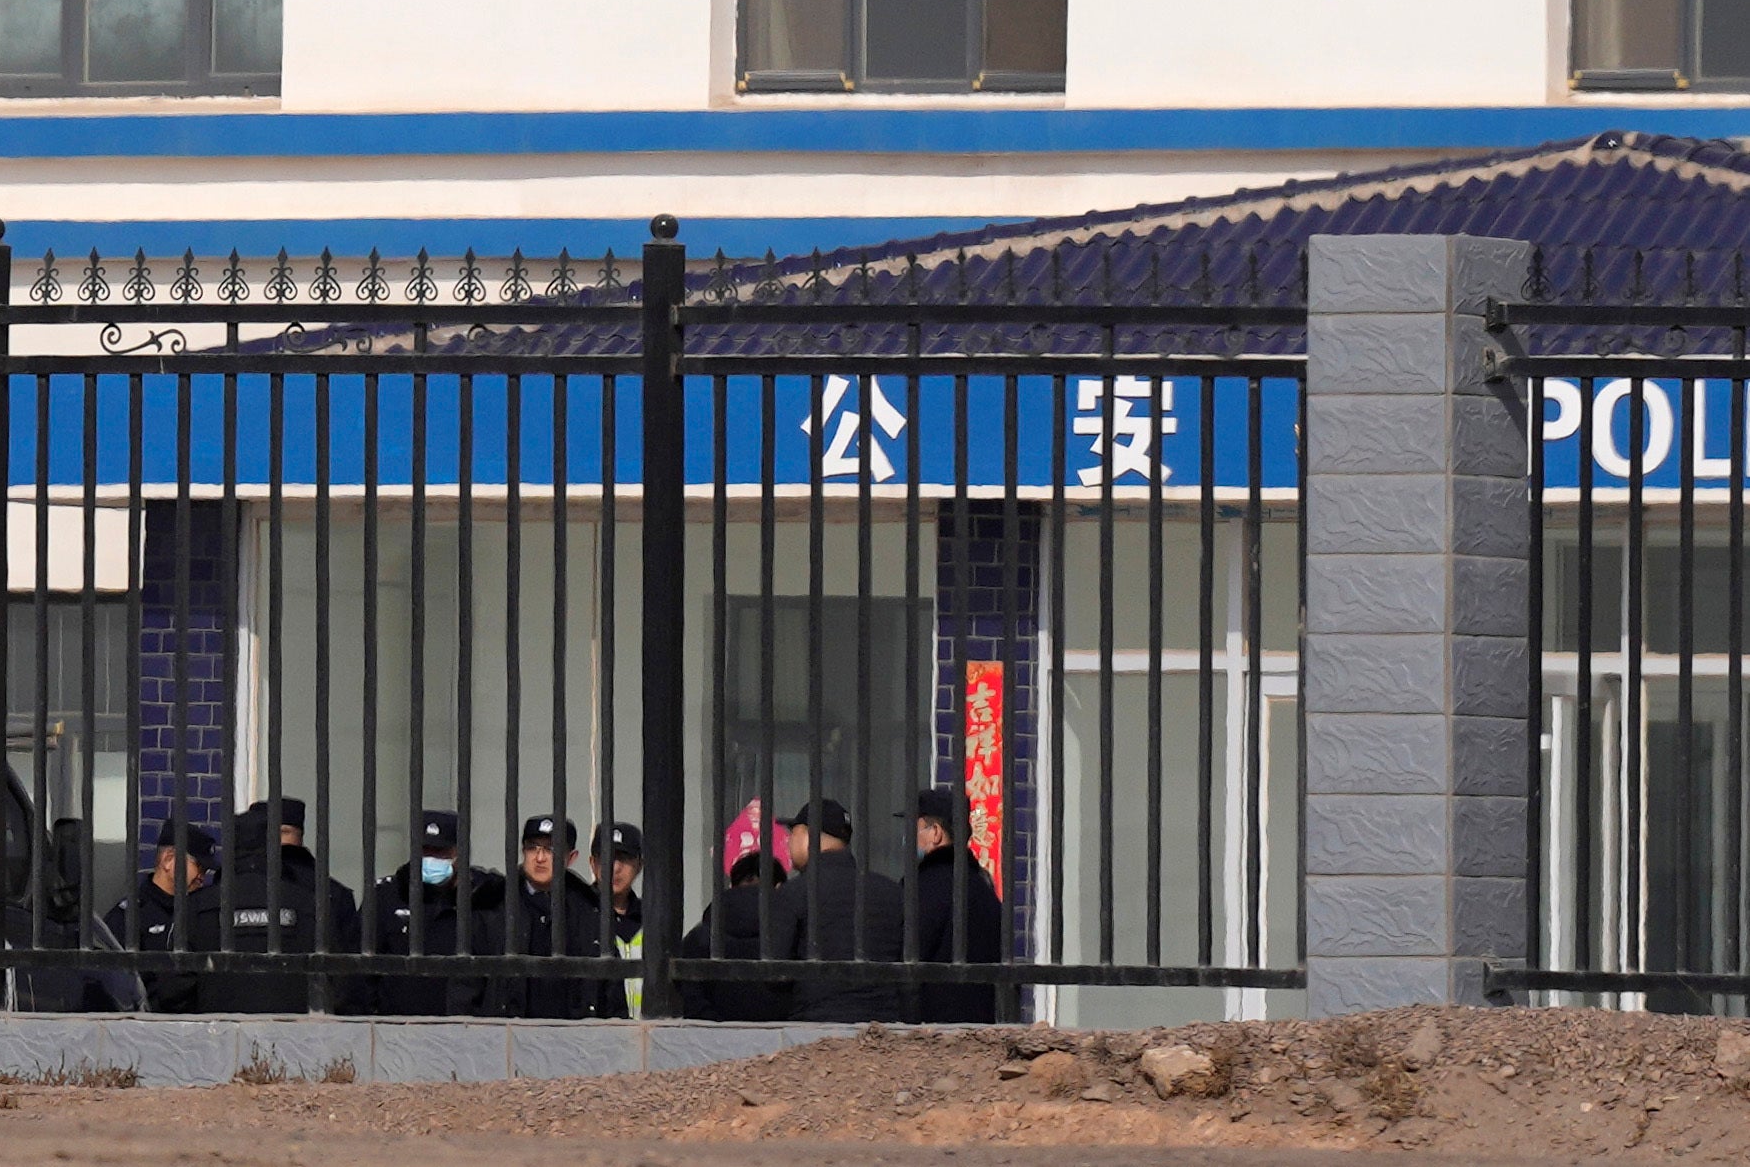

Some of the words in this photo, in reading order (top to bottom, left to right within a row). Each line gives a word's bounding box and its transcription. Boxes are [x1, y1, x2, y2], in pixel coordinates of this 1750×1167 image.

[801, 375, 1177, 486] 公安
[1527, 377, 1750, 478] POL
[239, 911, 270, 924] SWA
